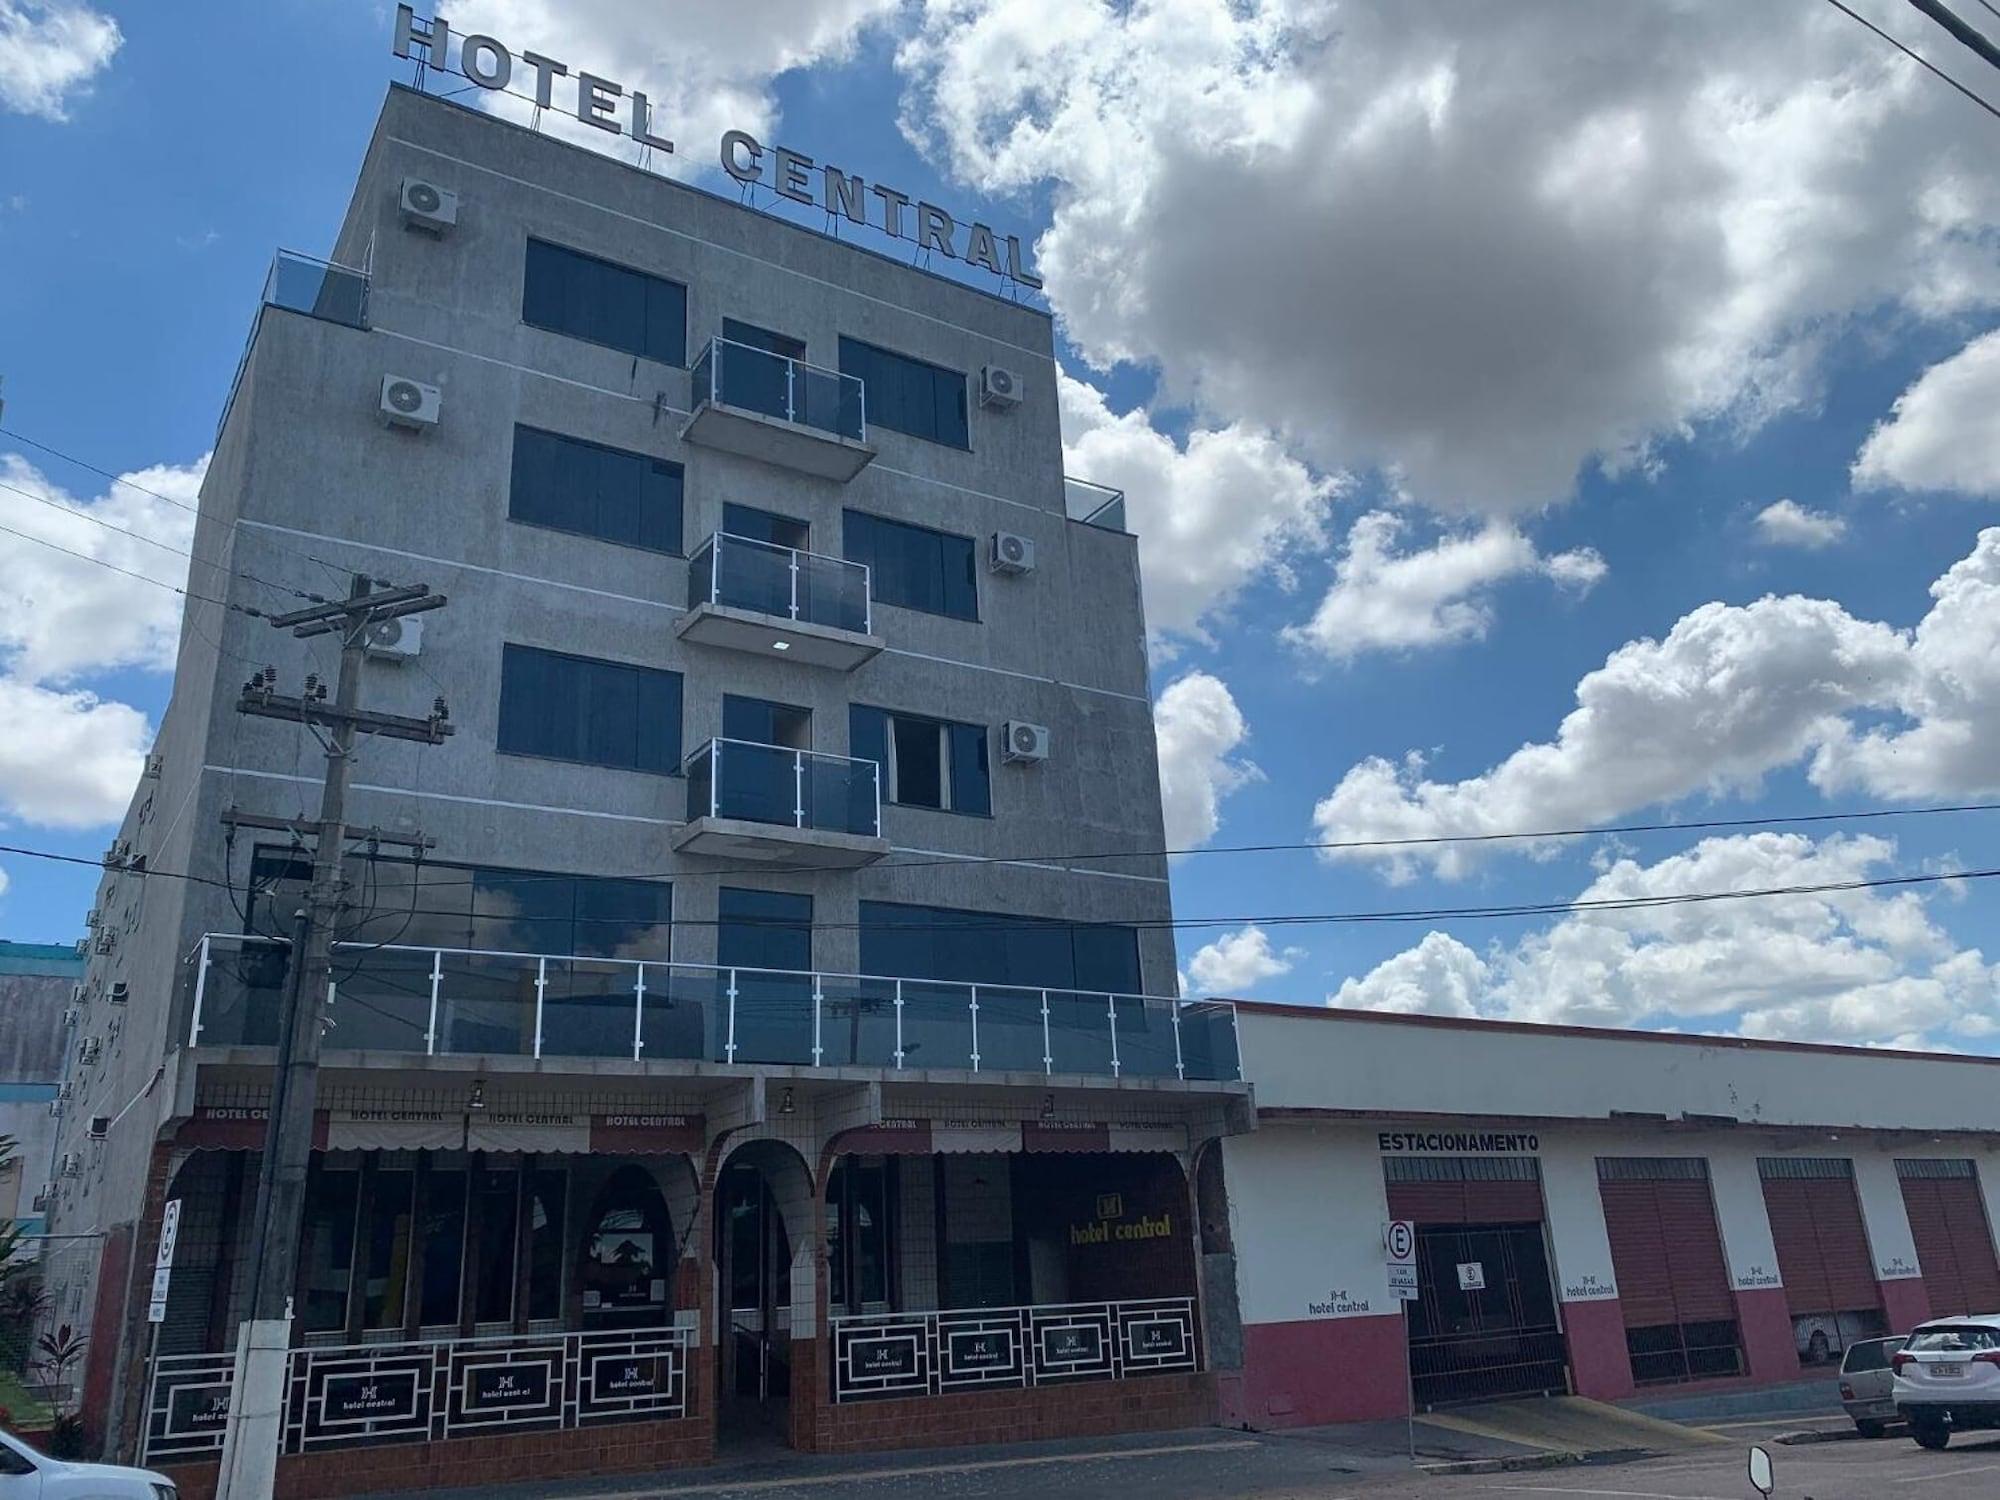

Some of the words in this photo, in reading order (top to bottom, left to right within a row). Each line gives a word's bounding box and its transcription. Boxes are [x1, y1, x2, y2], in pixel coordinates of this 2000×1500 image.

[393, 5, 674, 154] HOTEL
[719, 129, 1043, 289] CENTRAL
[206, 1108, 248, 1120] HOTEL
[351, 1110, 387, 1121] HOTEL
[606, 1115, 639, 1127] HOTEL
[640, 1115, 687, 1127] CENTRAL
[1378, 1132, 1540, 1152] ESTACIONAMENTO
[1070, 1220, 1109, 1245] hotel
[1115, 1213, 1171, 1240] central
[1395, 1228, 1406, 1254] E
[1566, 1285, 1587, 1297] hotel
[1588, 1283, 1614, 1296] central
[1309, 1302, 1334, 1314] hotel
[1336, 1300, 1369, 1313] central
